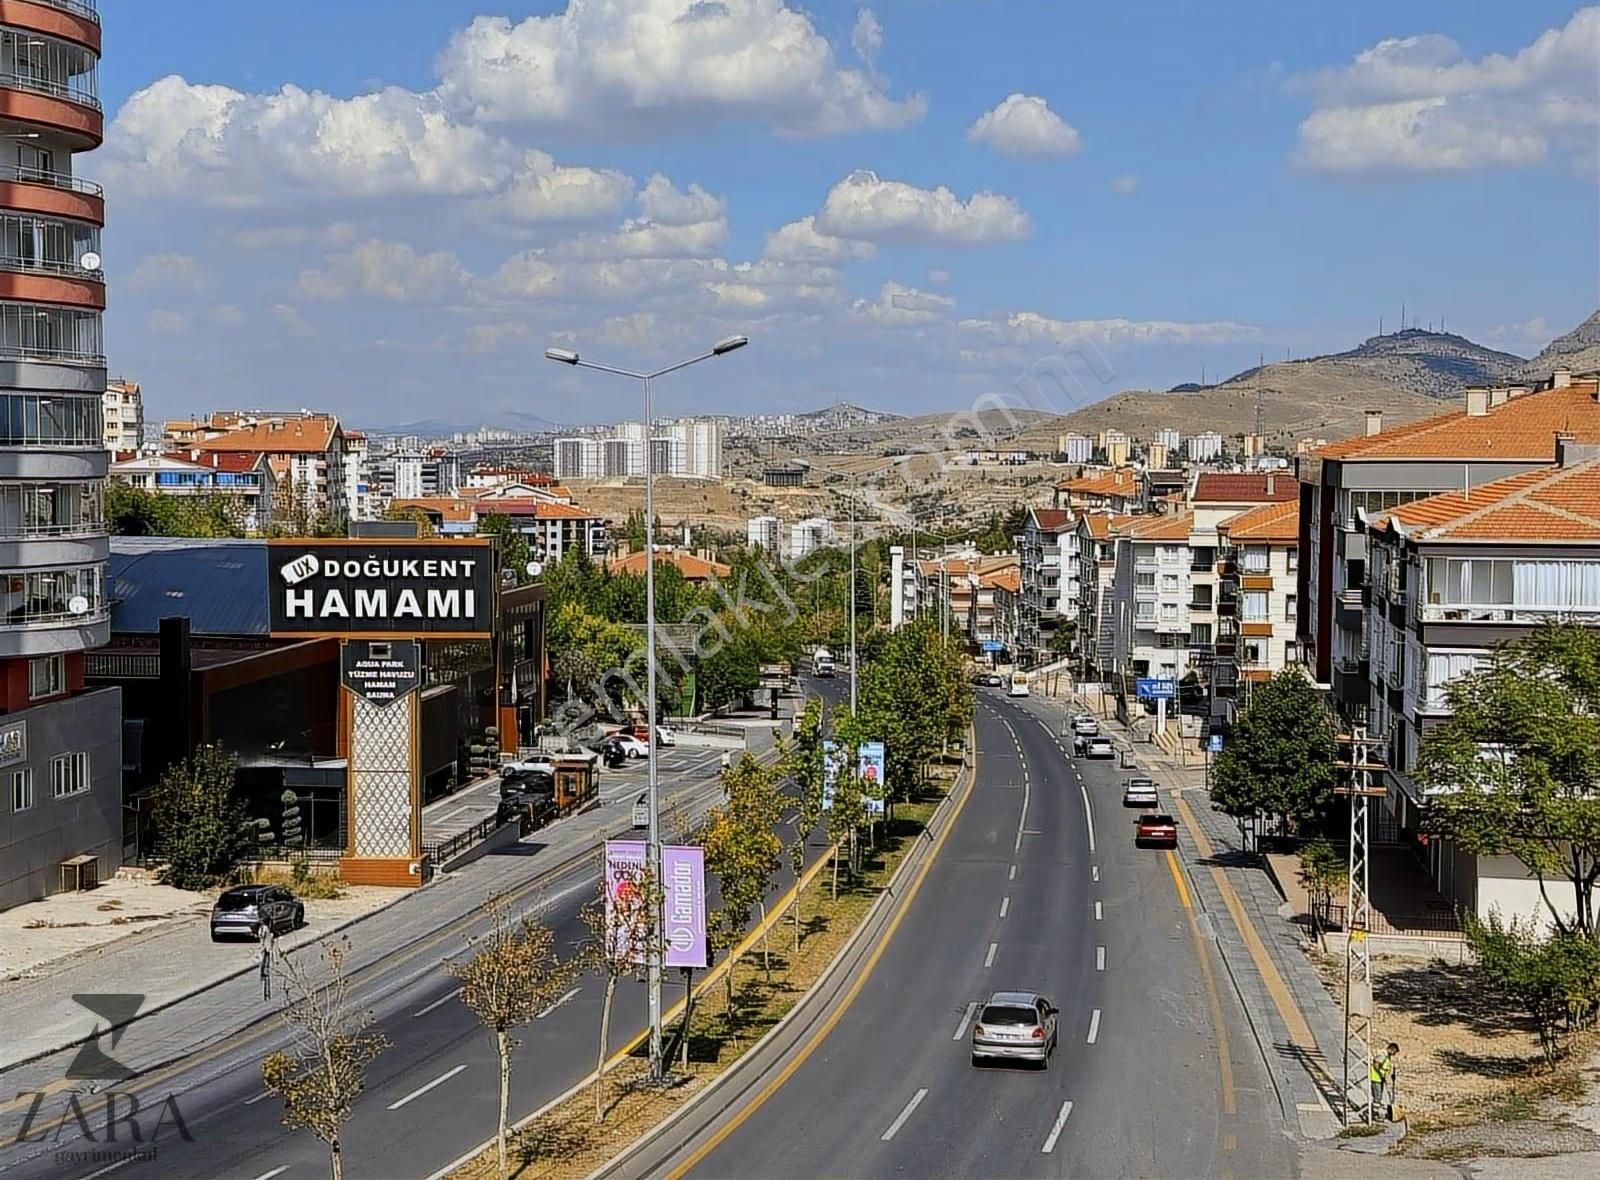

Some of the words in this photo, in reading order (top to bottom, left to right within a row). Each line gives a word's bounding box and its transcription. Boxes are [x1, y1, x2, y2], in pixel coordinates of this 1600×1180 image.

[292, 558, 314, 578] UX
[324, 554, 475, 577] DOĞUKENT
[286, 589, 475, 618] HAMAMI
